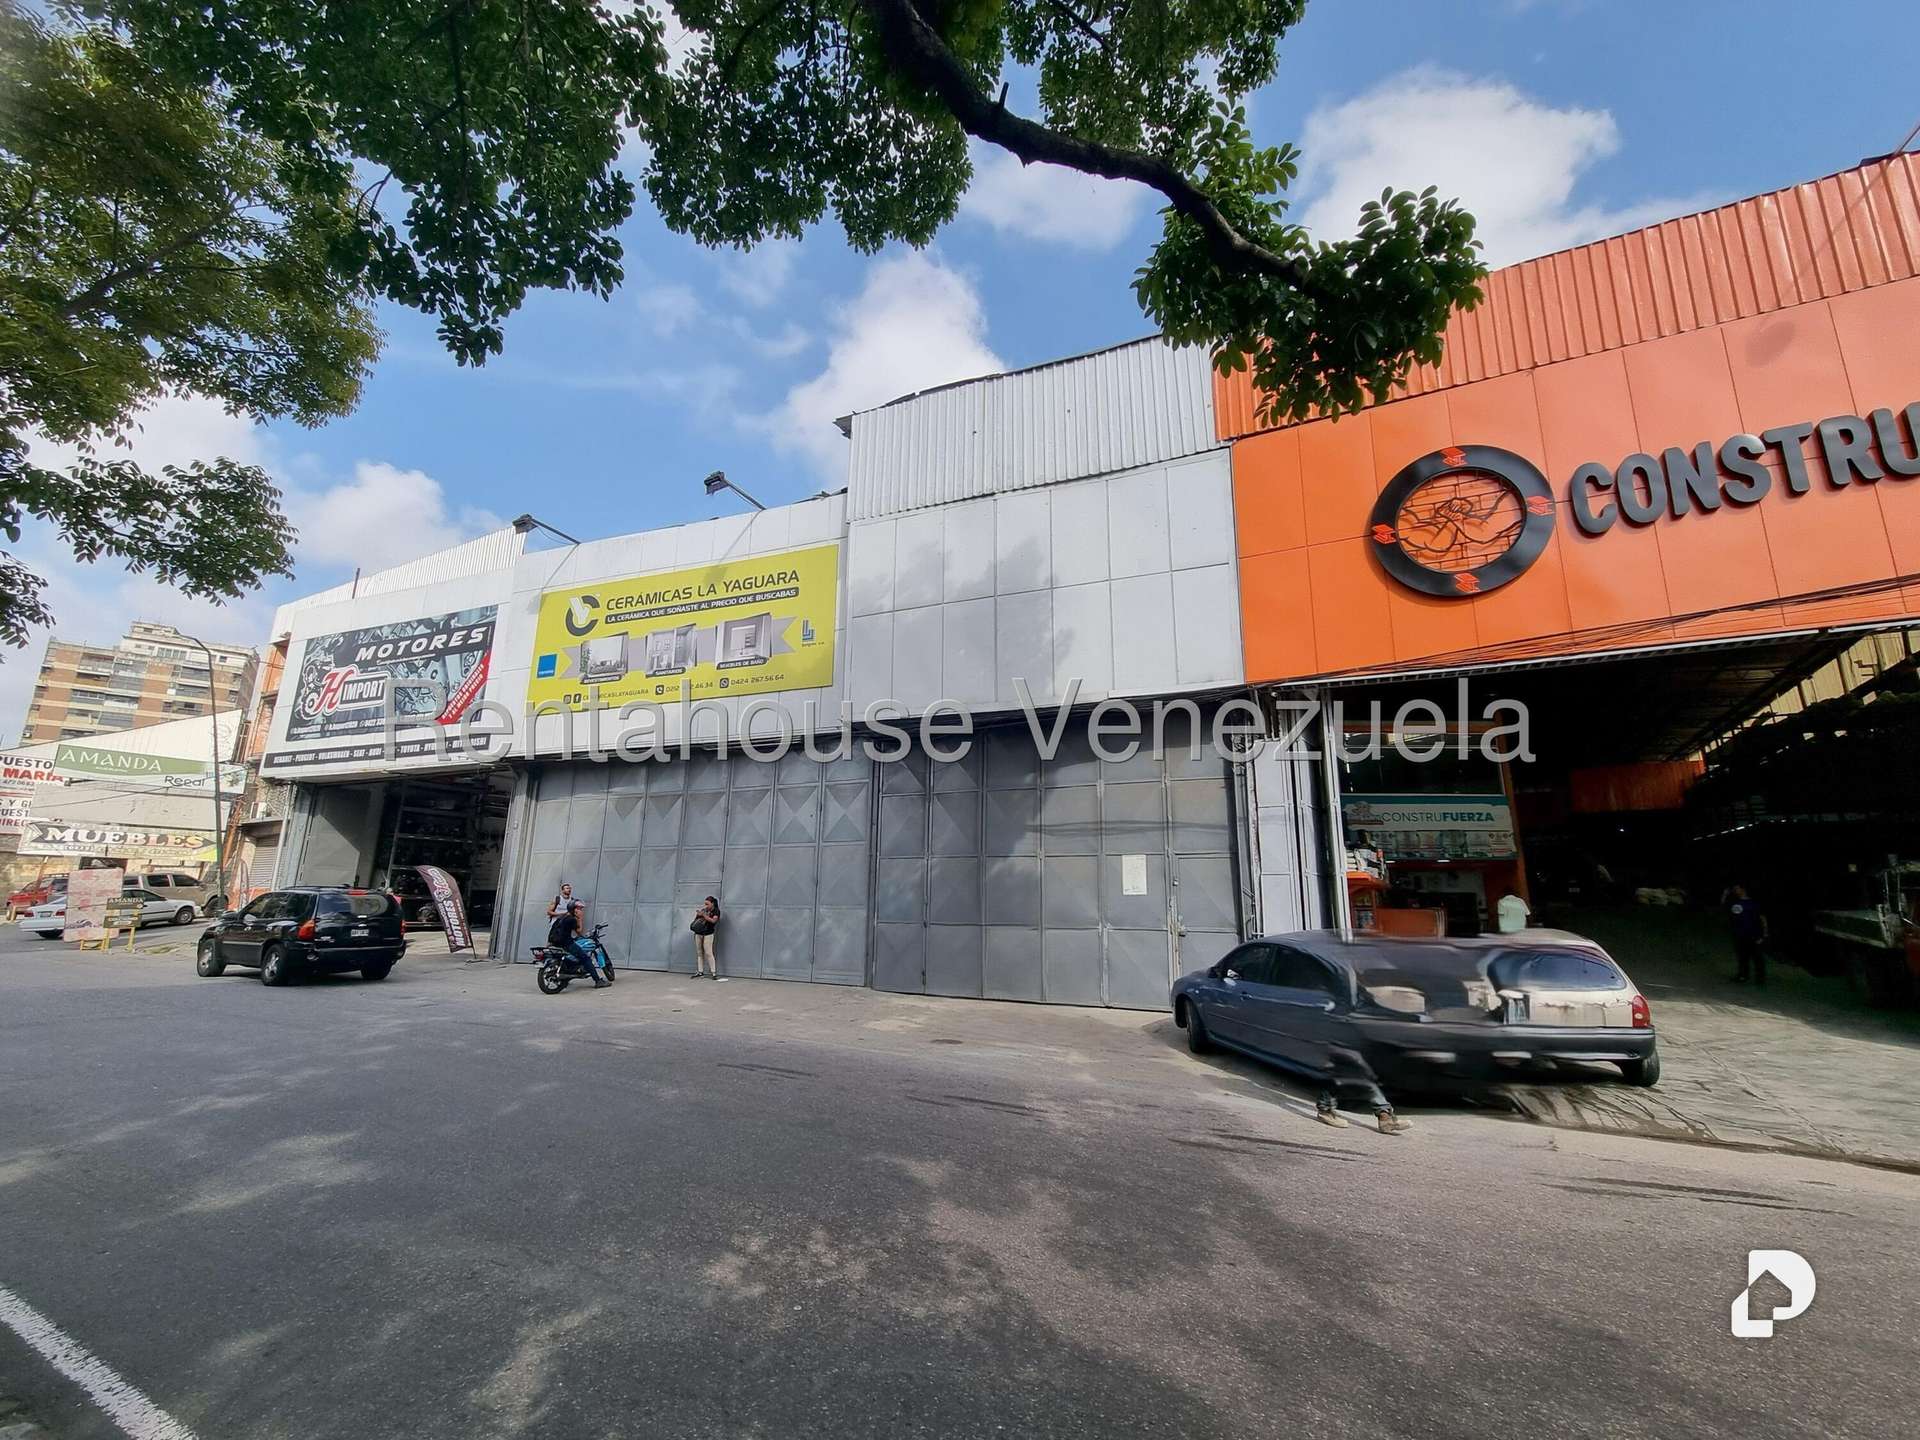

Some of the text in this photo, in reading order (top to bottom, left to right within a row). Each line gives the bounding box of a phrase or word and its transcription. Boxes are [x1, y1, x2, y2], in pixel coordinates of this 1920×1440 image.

[1569, 401, 1920, 535] CONSTRU
[606, 569, 800, 611] CERÁMICAS LA YAGUARA
[607, 615, 616, 623] LA
[651, 607, 666, 616] QUE
[667, 603, 699, 614] SOÑASTE
[699, 602, 710, 610] AL
[711, 598, 737, 608] PRECIO
[738, 596, 754, 605] QUE
[755, 588, 797, 600] BUSCABAS
[355, 627, 489, 662] MOTORES
[342, 679, 386, 701] IMPORT
[61, 749, 162, 772] AMANDA
[1382, 812, 1494, 822] CONSTRUFUERZA
[45, 828, 205, 849] MUEBLES
[443, 899, 466, 947] MOTORES
